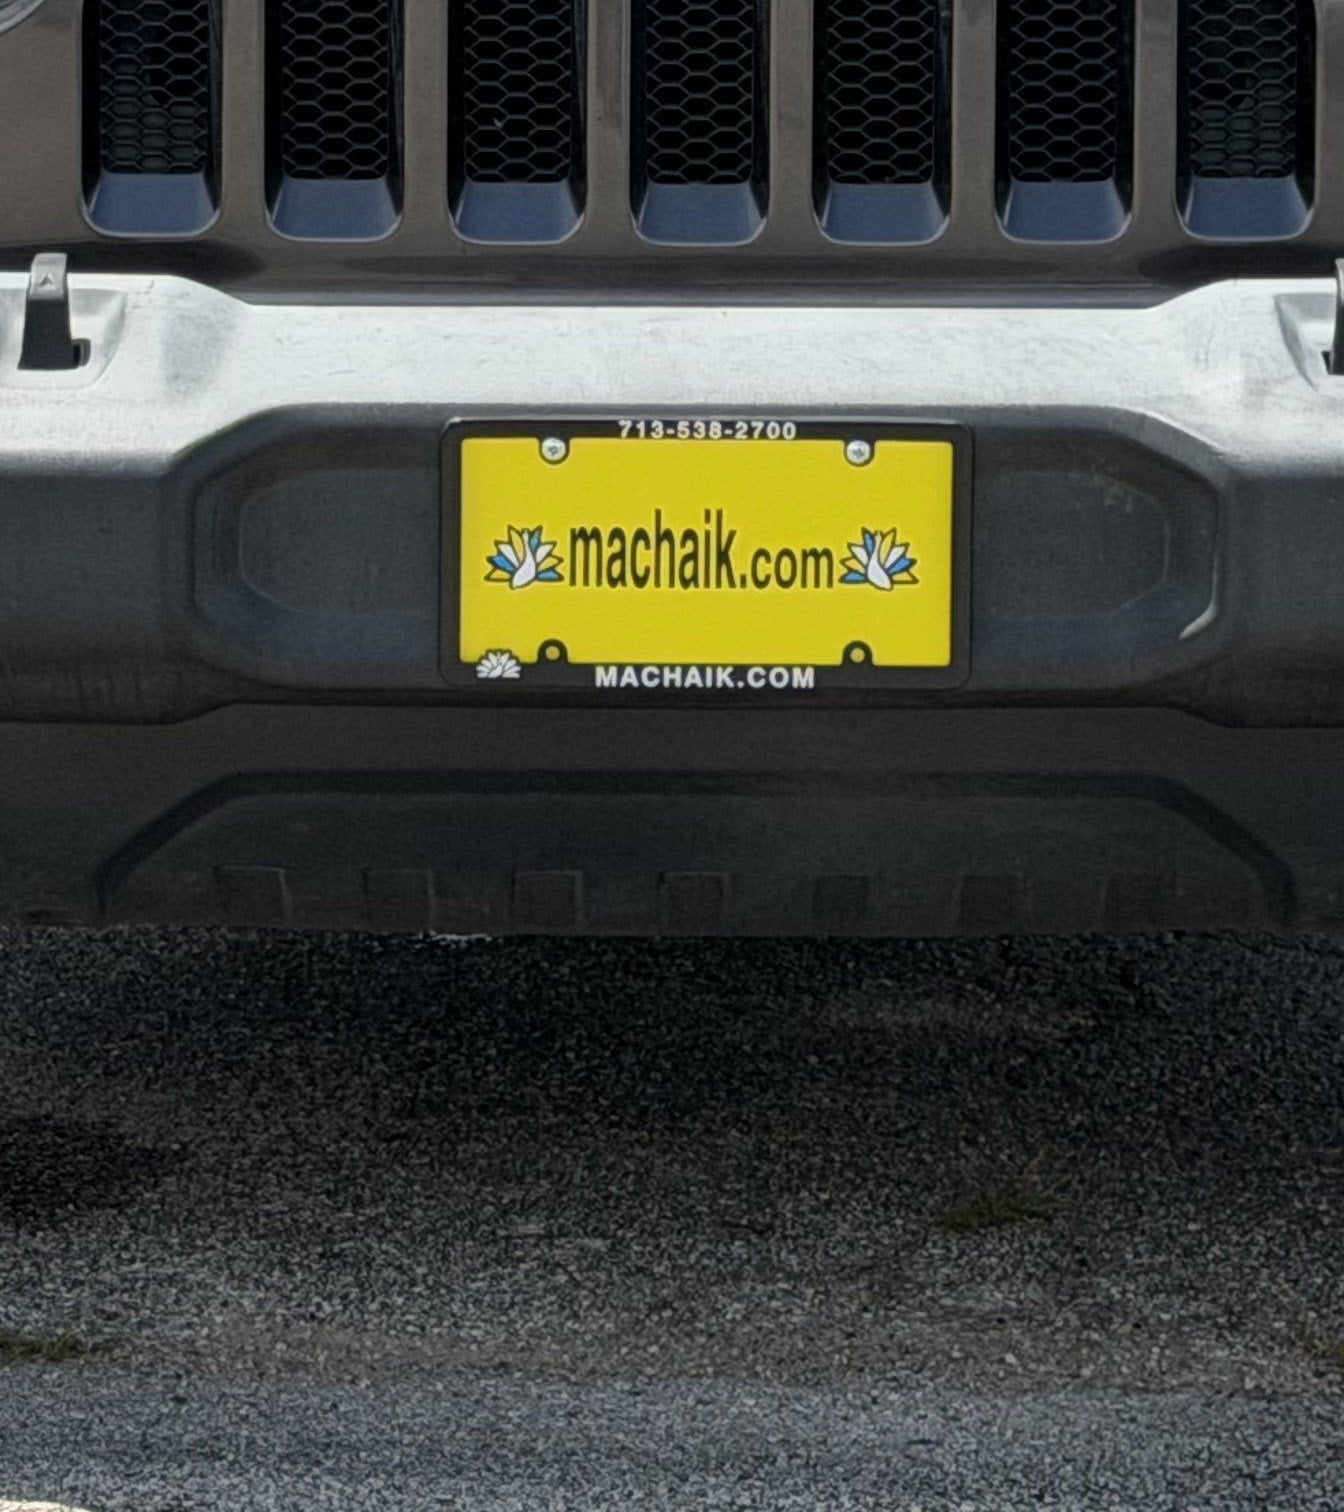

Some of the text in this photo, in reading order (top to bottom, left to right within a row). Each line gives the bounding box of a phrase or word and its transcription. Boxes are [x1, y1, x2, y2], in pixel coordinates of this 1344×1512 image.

[617, 419, 797, 441] 713-538-2700
[568, 508, 835, 590] machaik.com
[594, 665, 816, 689] MACHAIK.COM
